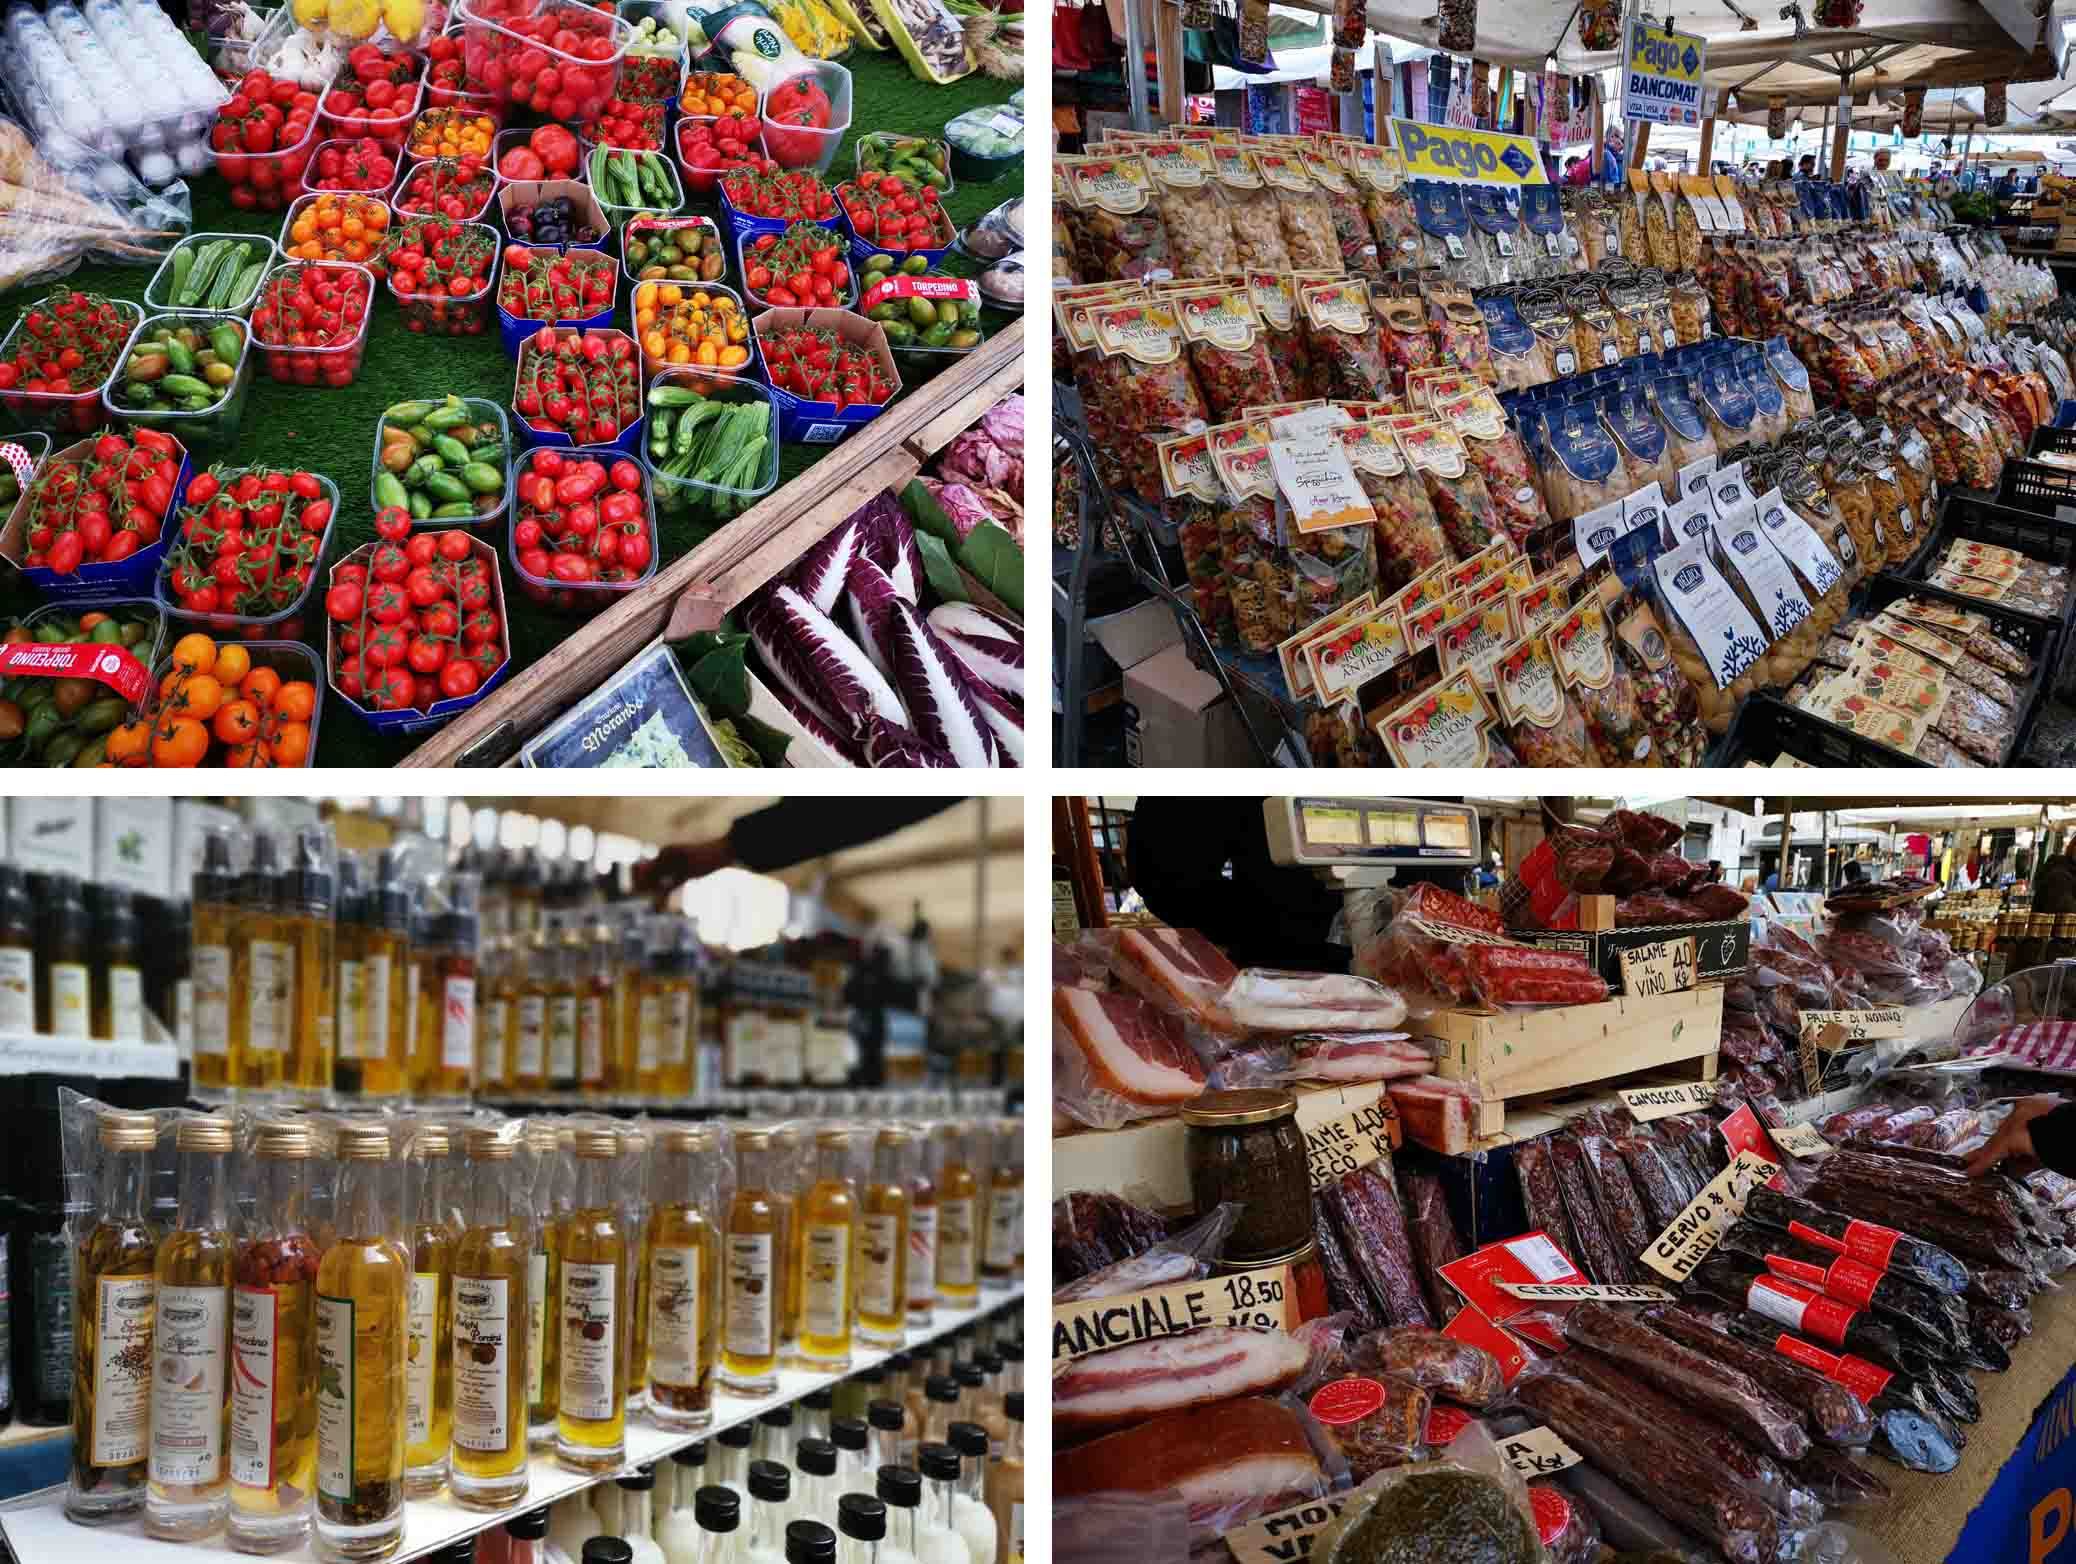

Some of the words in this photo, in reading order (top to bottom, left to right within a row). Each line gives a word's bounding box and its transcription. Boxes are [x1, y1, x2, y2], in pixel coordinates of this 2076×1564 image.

[1633, 24, 1680, 74] Pago
[1630, 74, 1698, 102] BANCOMAT
[1397, 123, 1498, 178] Pago
[911, 281, 958, 292] TORPEDINO
[9, 652, 78, 667] TORPEDINO
[1342, 646, 1392, 680] ANTIQVA
[1343, 638, 1383, 662] ROMA
[1420, 705, 1461, 738] ROMA
[1423, 714, 1473, 754] ANTIQVA
[1627, 943, 1668, 966] SALAME
[1673, 942, 1693, 969] 40
[1644, 964, 1656, 975] AL
[1635, 972, 1667, 998] VINO
[1806, 1012, 1844, 1024] PALLE
[1865, 1011, 1902, 1023] NONNO
[1627, 1087, 1685, 1108] CAMOSCIO
[1306, 1122, 1350, 1150] AME
[1752, 1163, 1777, 1180] Kg
[1656, 1205, 1711, 1259] CERVO
[1517, 1284, 1601, 1298] CERVO
[1052, 1292, 1213, 1359] ANCIALE
[1223, 1275, 1284, 1311] 18.50
[2030, 1487, 2076, 1564] P
